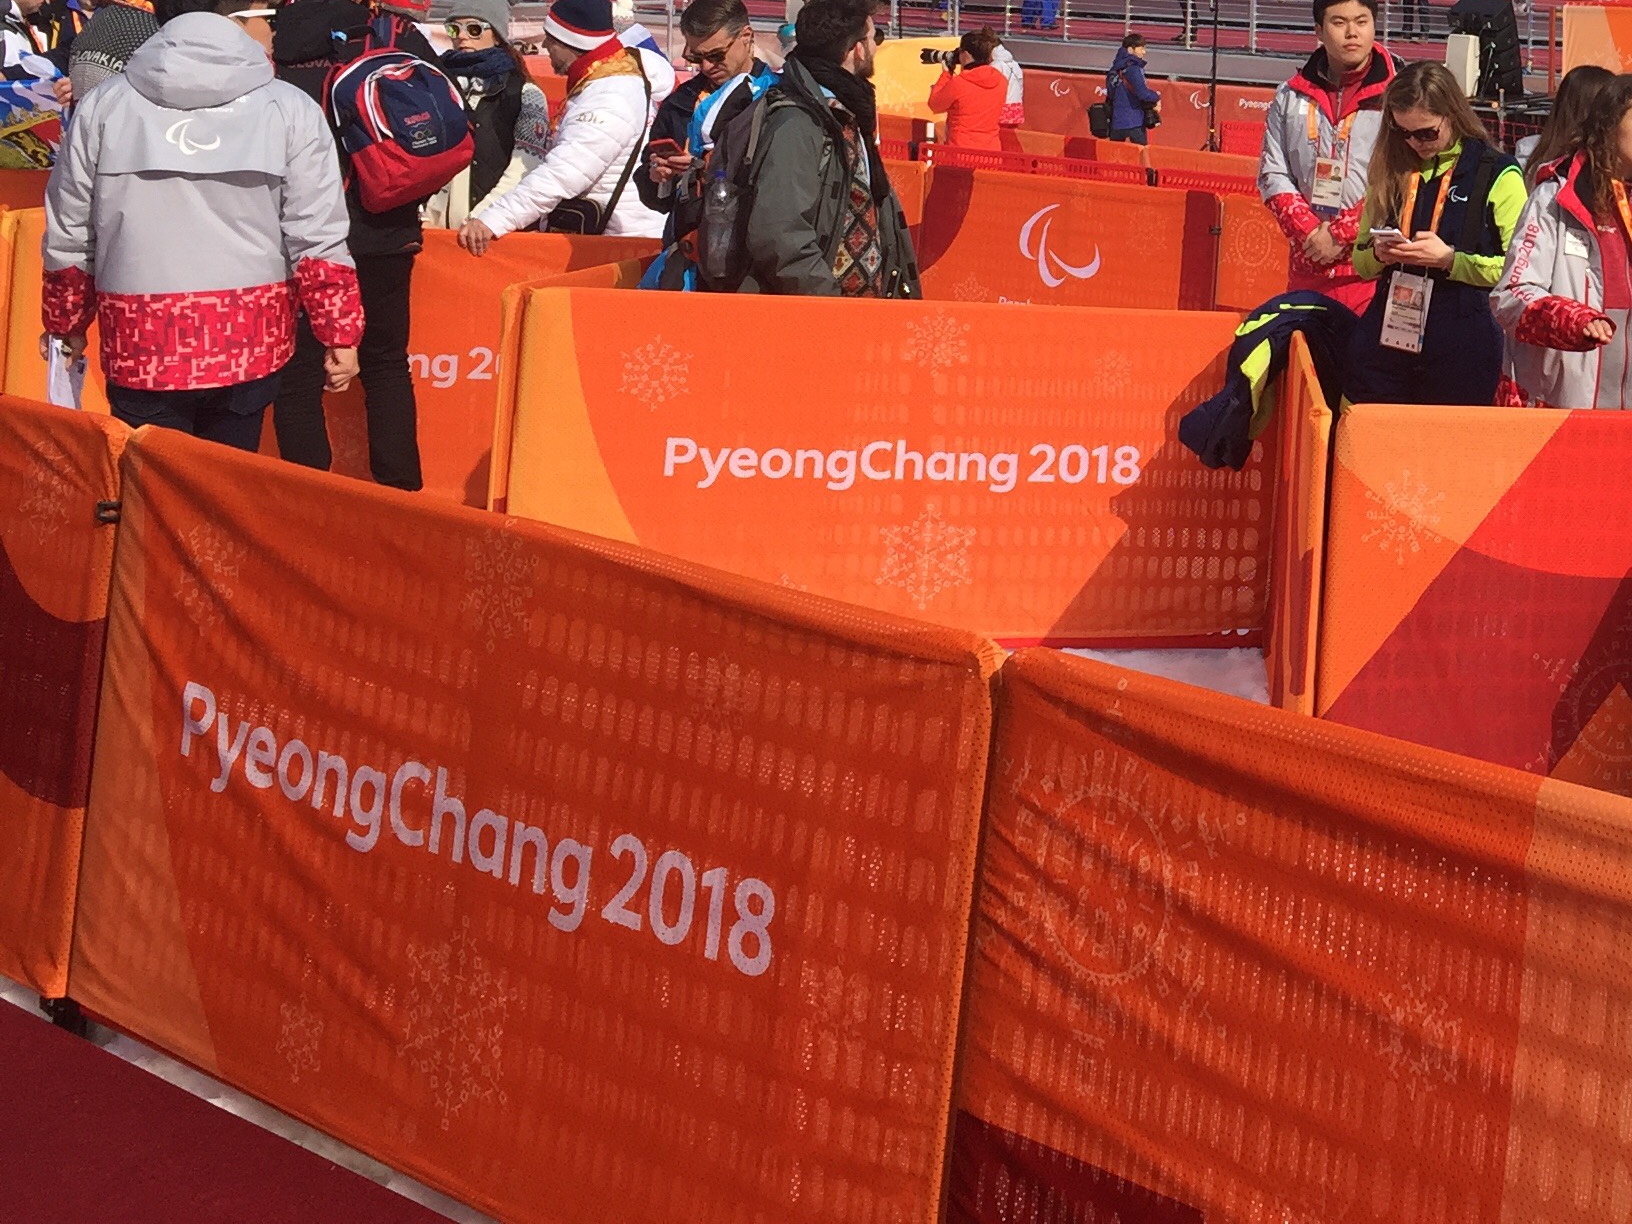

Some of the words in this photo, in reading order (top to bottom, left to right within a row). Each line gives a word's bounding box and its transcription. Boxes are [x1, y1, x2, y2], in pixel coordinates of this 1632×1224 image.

[663, 437, 1019, 493] PyeongChang
[1027, 444, 1141, 485] 2018
[180, 681, 593, 933] PyeongChang
[601, 833, 776, 977] 2018
